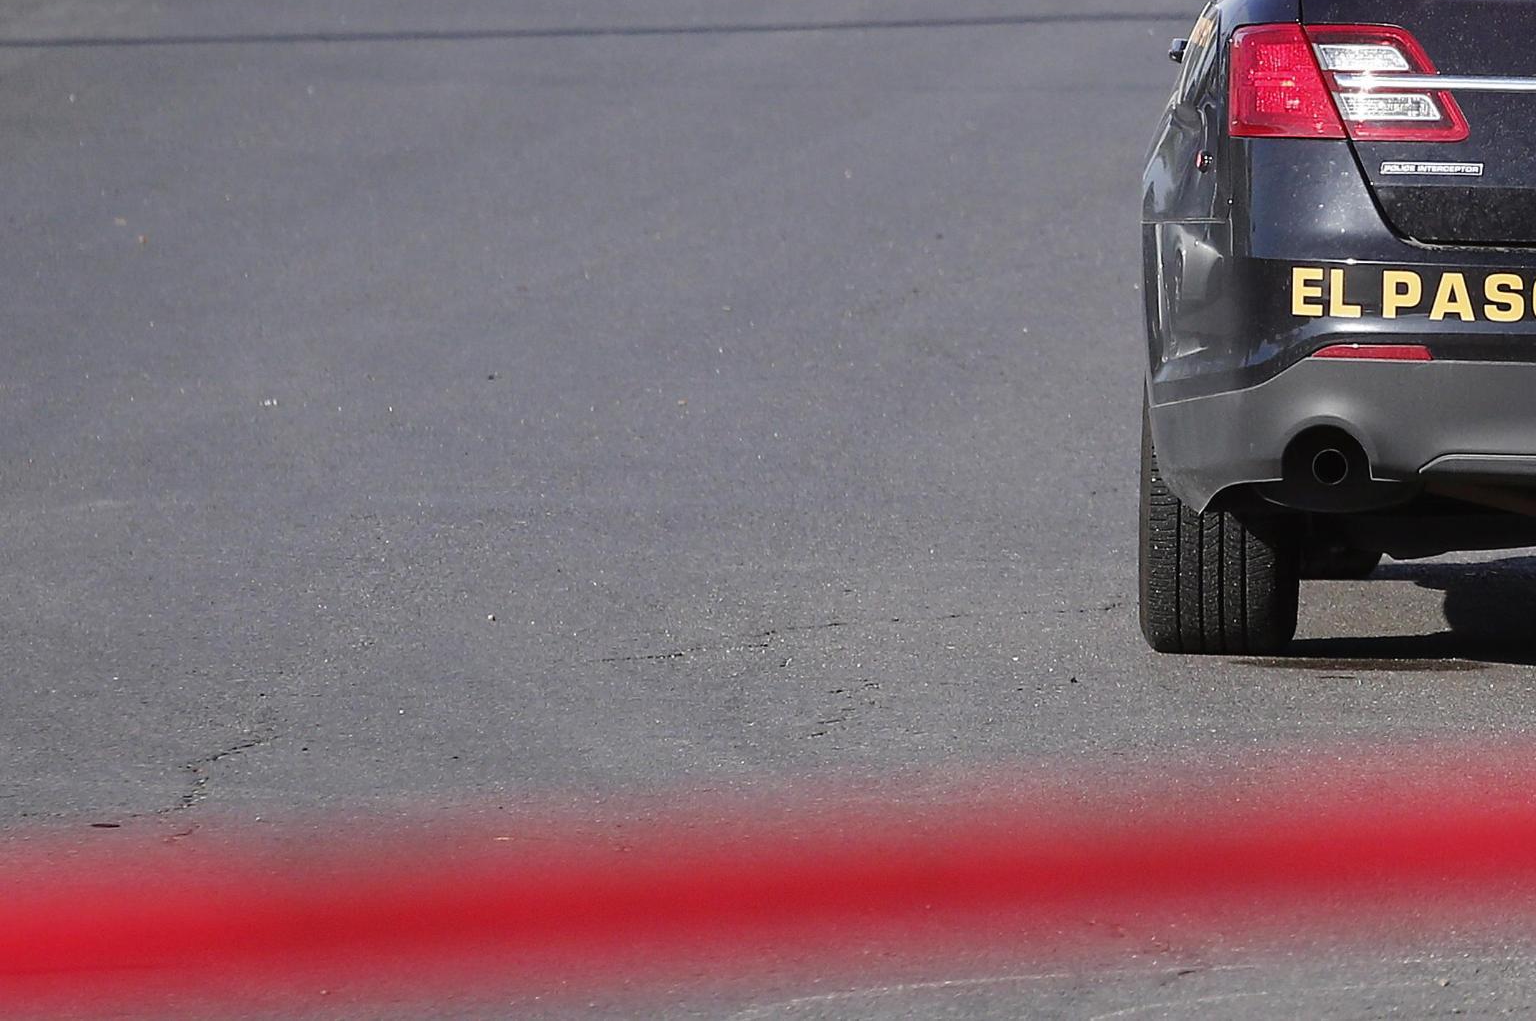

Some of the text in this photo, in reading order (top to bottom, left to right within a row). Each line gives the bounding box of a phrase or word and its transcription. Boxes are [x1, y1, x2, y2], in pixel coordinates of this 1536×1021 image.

[1383, 164, 1479, 173] POLICE INTERCEPTOR
[1292, 267, 1361, 318] EL
